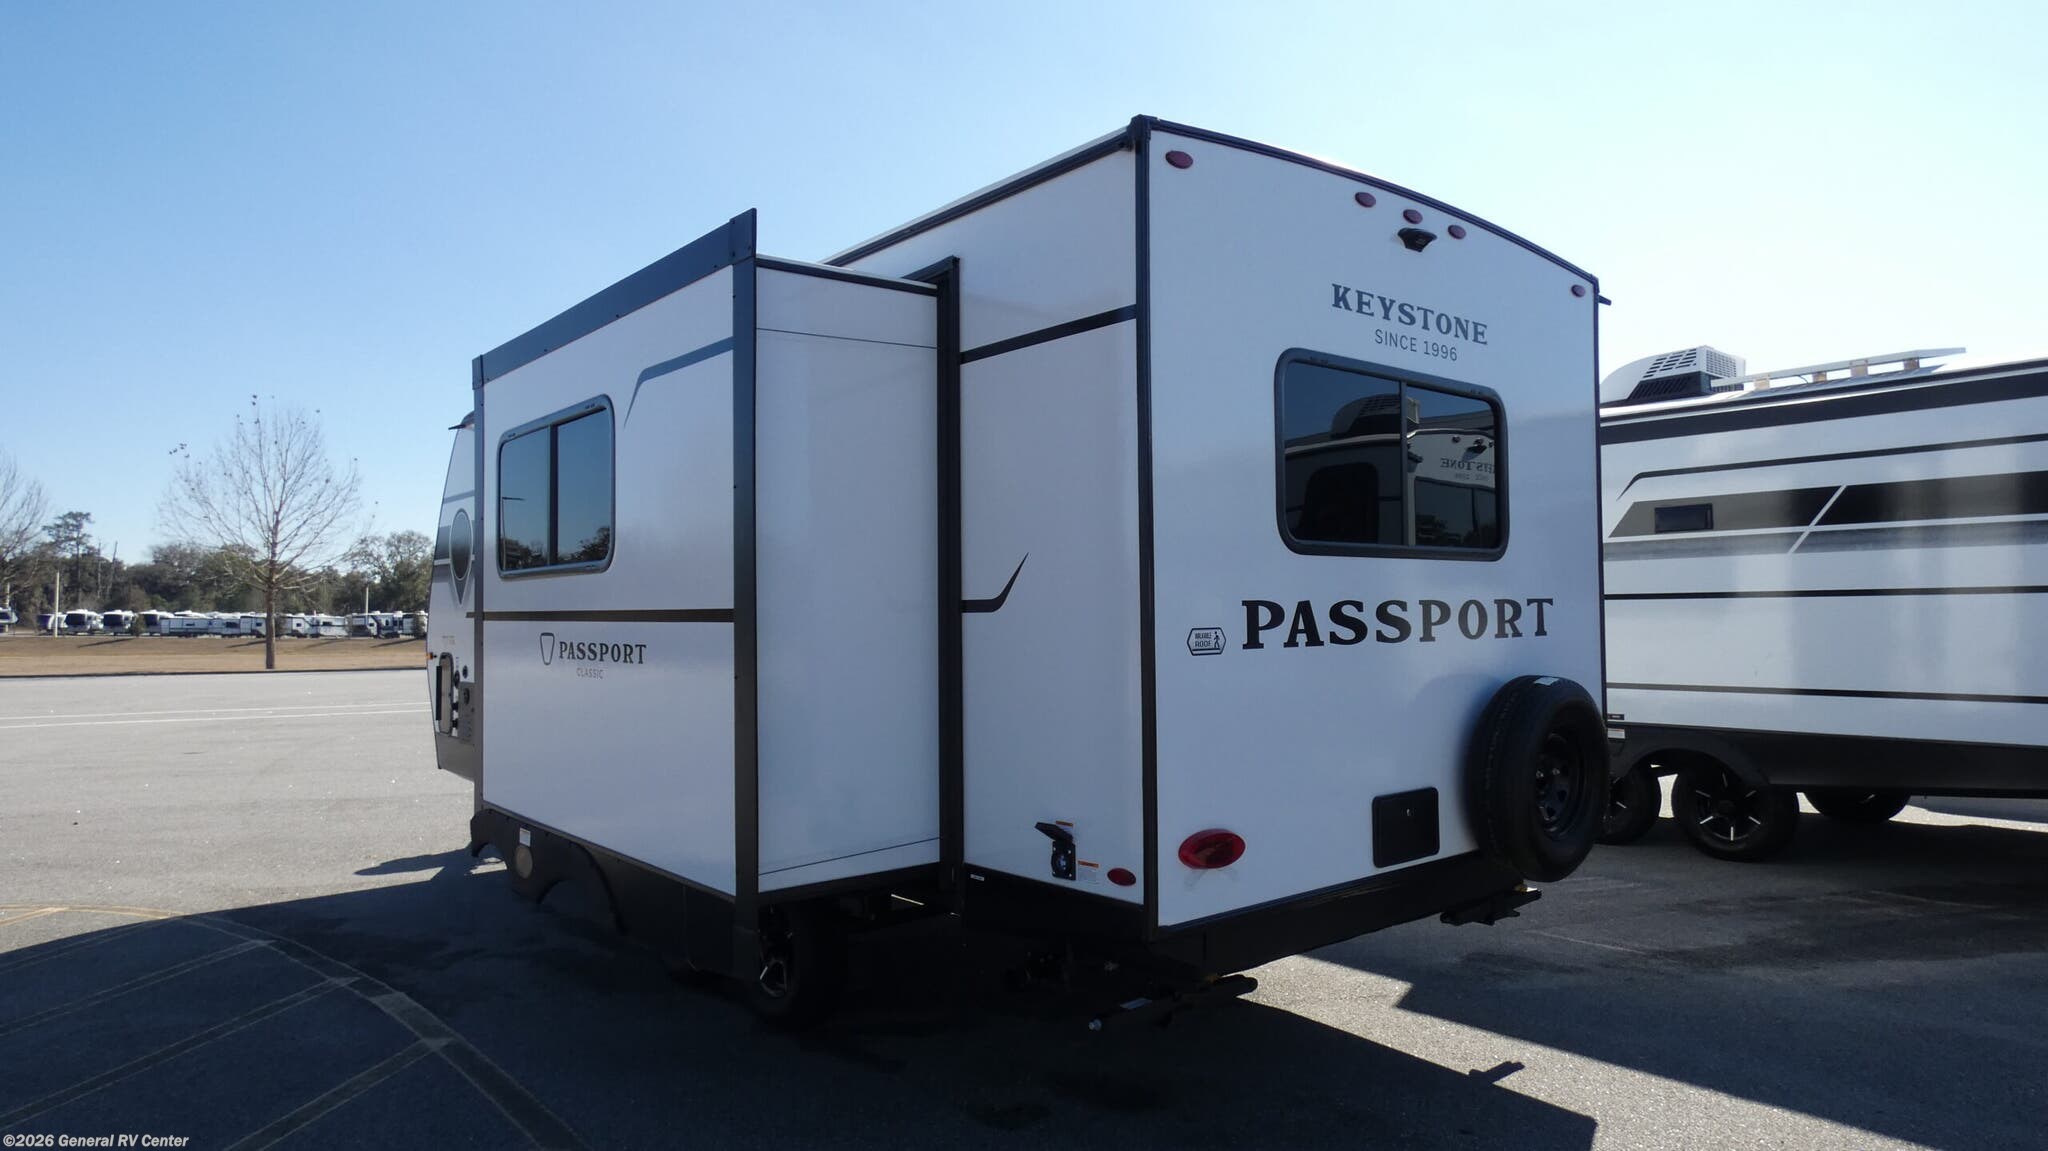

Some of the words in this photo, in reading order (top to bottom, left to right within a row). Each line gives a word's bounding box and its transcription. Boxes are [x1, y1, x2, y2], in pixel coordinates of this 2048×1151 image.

[1331, 283, 1488, 345] KEYSTONE
[1374, 328, 1417, 352] SINCE
[1423, 340, 1457, 361] 1996
[1241, 598, 1554, 650] PASSPORT
[559, 641, 647, 665] PASSPORT
[576, 667, 604, 680] CLASSIC
